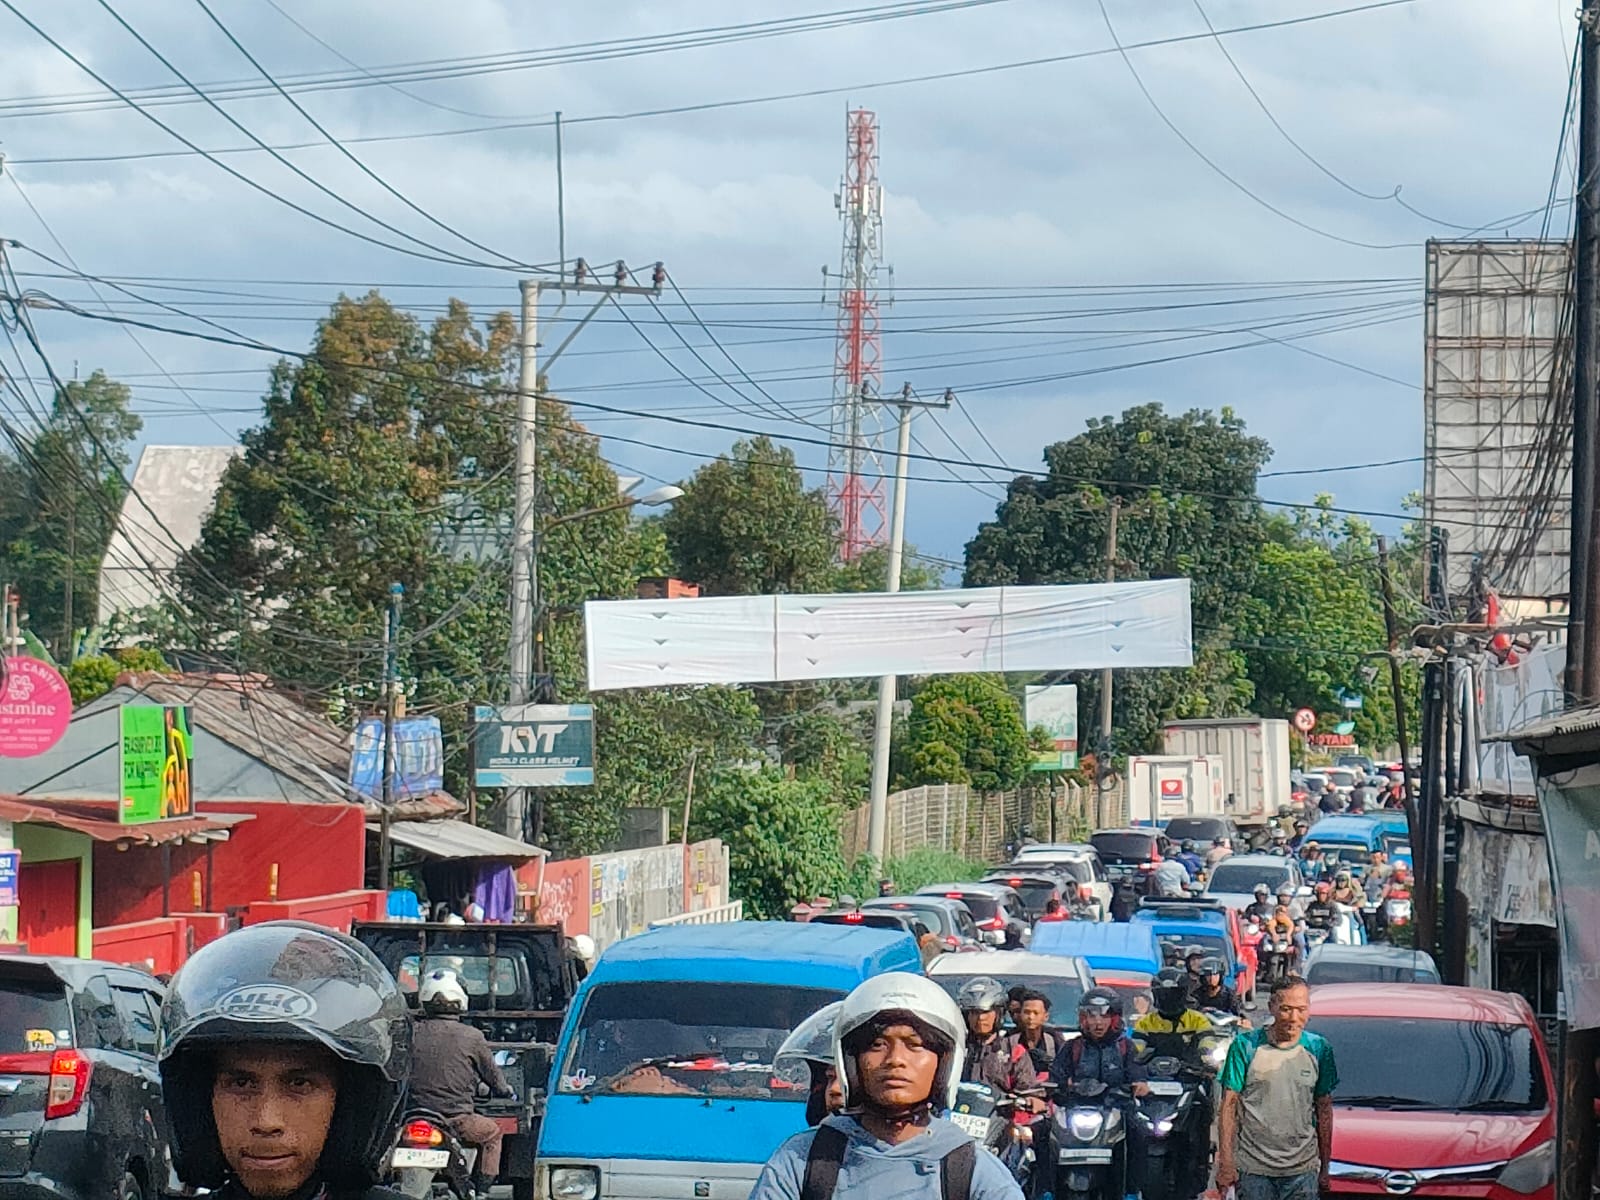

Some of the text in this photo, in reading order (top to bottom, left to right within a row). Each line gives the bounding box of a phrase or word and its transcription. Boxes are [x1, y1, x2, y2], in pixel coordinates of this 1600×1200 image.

[22, 661, 63, 694] CANTIK
[500, 724, 568, 754] KYT
[223, 991, 311, 1014] NHK
